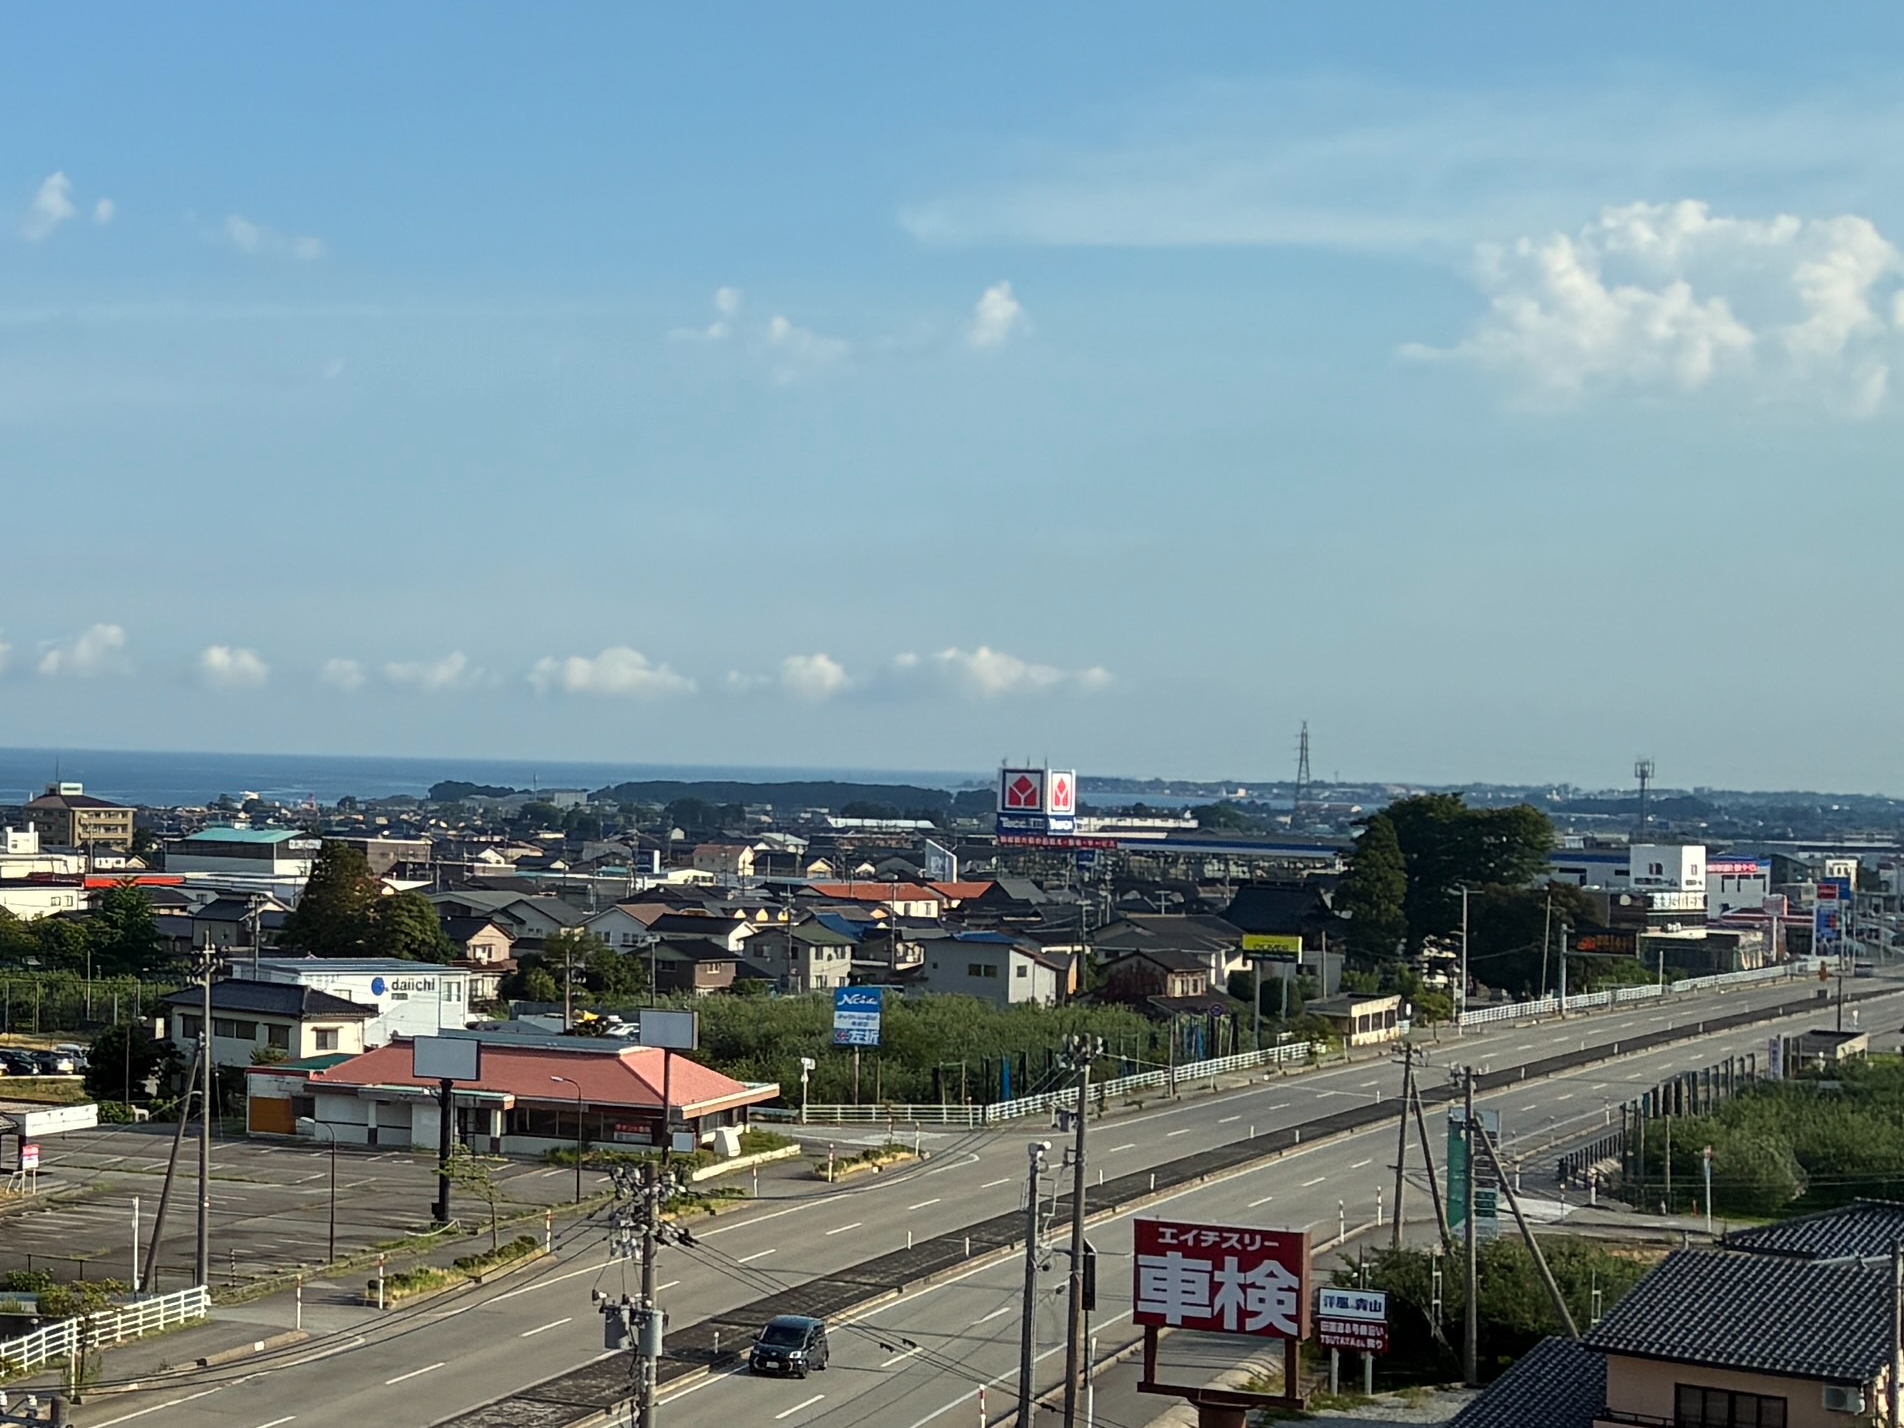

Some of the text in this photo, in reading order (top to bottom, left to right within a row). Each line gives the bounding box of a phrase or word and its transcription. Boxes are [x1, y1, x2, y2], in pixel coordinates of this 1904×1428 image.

[391, 978, 435, 992] daiichi
[1158, 1227, 1279, 1251] エイチスリー
[1137, 1251, 1299, 1336] 車検
